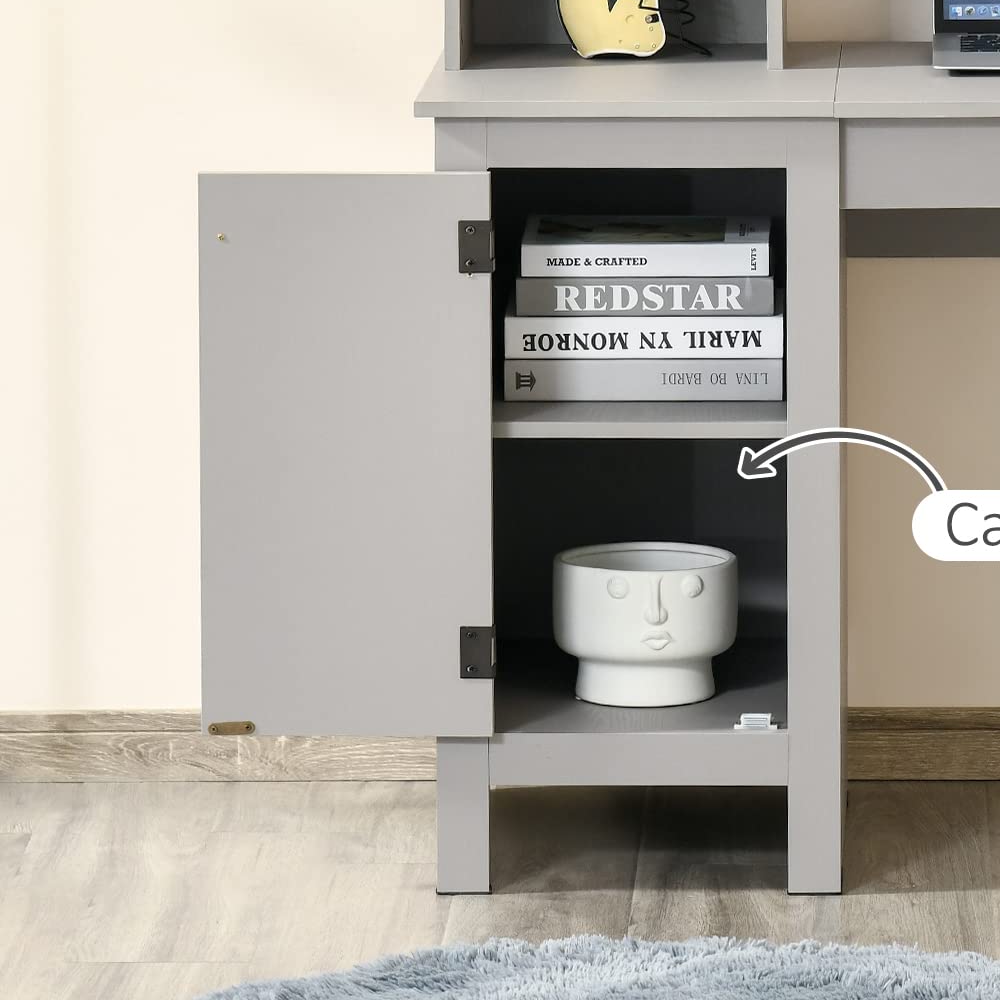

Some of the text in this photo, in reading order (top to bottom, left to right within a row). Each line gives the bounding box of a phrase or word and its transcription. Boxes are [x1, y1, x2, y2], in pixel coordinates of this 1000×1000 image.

[546, 257, 648, 267] MADE & CRAFTED
[553, 283, 745, 312] REDSTAR
[522, 330, 762, 352] MARIL YN MONROE
[661, 372, 769, 385] LINA BO BARDI
